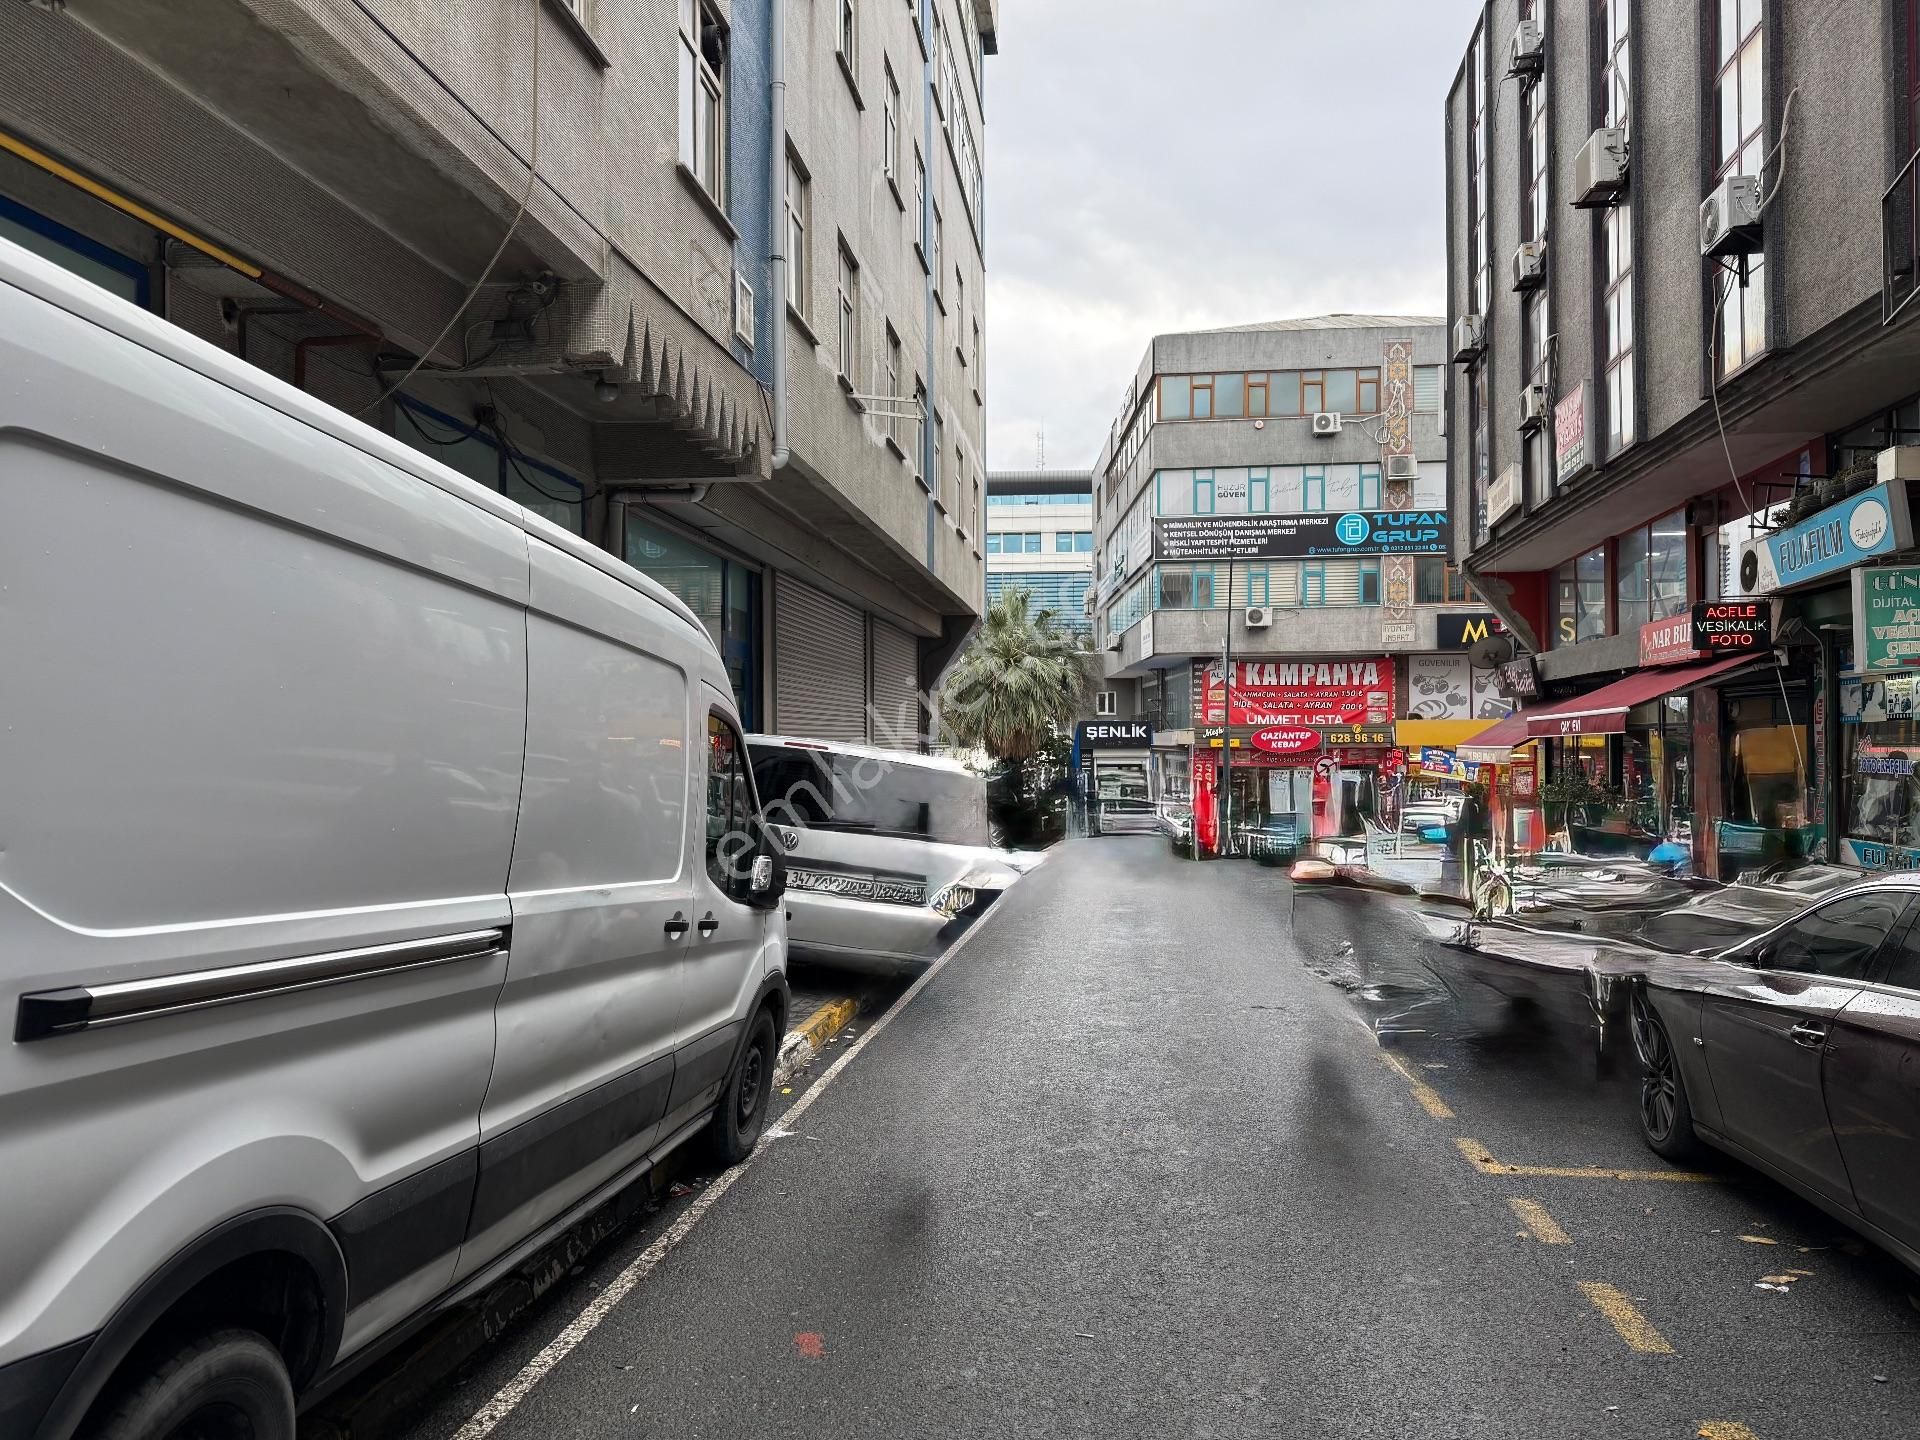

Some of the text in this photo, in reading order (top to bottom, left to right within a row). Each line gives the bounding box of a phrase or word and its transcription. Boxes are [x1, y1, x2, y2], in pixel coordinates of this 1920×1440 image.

[1217, 490, 1246, 499] GÜVEN
[1168, 517, 1329, 529] MİMARLIK VE MÜHENDİSLİK ARAŞTIRMA MERKEZİ
[1372, 512, 1447, 526] TUFAN
[1169, 530, 1198, 538] KENTSEL
[1234, 528, 1266, 537] DANIŞMA
[1267, 527, 1297, 535] MERKEZİ
[1372, 529, 1439, 543] GRUP
[1169, 538, 1190, 547] RİSKLİ
[1205, 538, 1228, 546] TESPİT
[1779, 518, 1845, 575] FUJIFILM
[1169, 546, 1219, 556] MÜTEAHHİTLİK
[1873, 595, 1916, 608] DİJİTAL
[1706, 605, 1757, 618] ACELE
[1697, 619, 1767, 632] VESİKALIK
[1652, 628, 1671, 650] NAR
[1710, 633, 1753, 646] FOTO
[1245, 662, 1379, 687] KAMPANYA
[1239, 690, 1276, 698] LAHMACUN
[1232, 700, 1253, 709] PİDE
[1262, 701, 1294, 709] SALATA
[1303, 701, 1333, 709] AYRAN
[1340, 703, 1355, 711] 200
[1246, 712, 1344, 725] ÜMMET USTA
[1086, 723, 1147, 741] ŞENLİK
[1260, 730, 1312, 741] GAZİANTEP
[1330, 733, 1384, 743] 628 96 16
[1271, 740, 1302, 749] KEBAP
[1423, 761, 1434, 770] 75
[791, 871, 810, 885] 347
